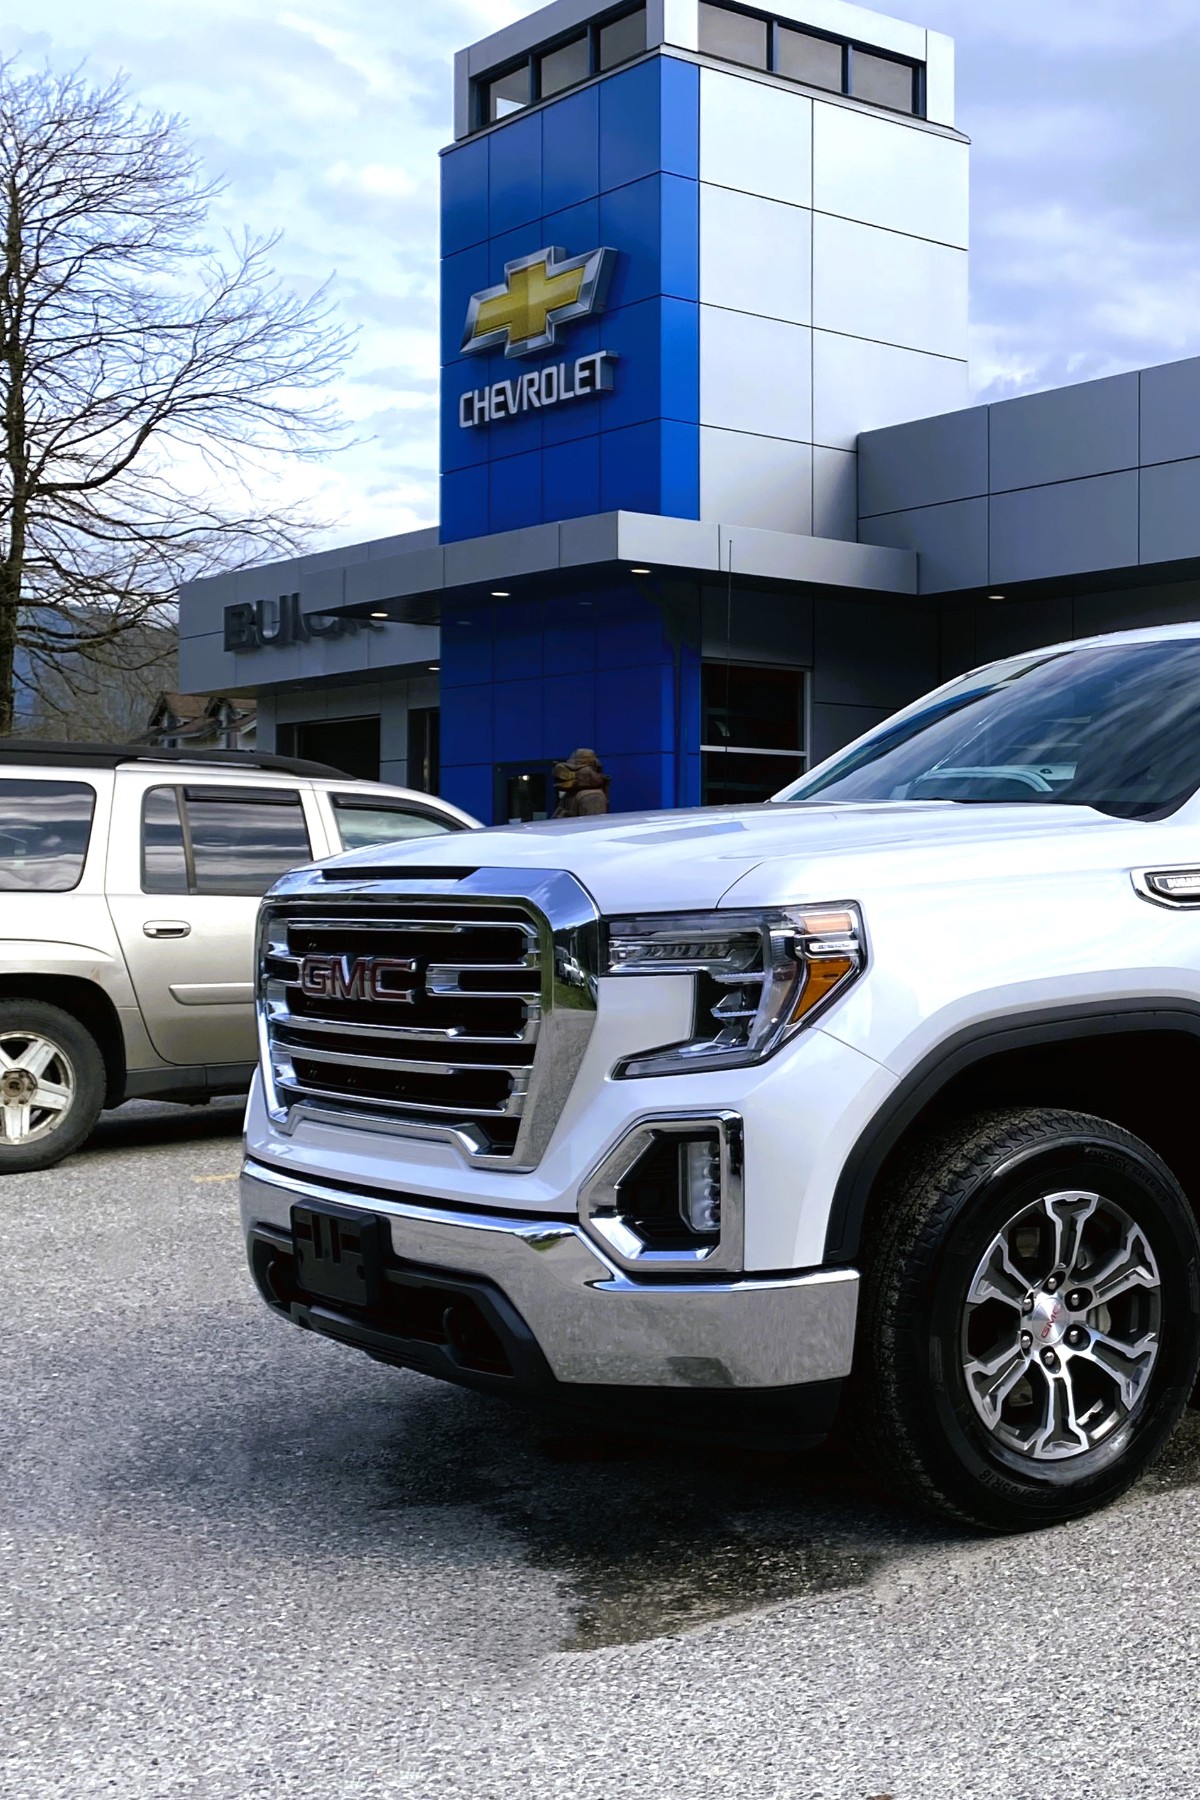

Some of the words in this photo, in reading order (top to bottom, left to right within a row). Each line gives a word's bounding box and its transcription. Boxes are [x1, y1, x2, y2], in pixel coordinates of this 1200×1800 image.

[459, 350, 611, 428] CHEVROLET
[224, 592, 385, 652] BUI
[301, 954, 418, 1004] GMC
[1041, 1302, 1062, 1338] GMC
